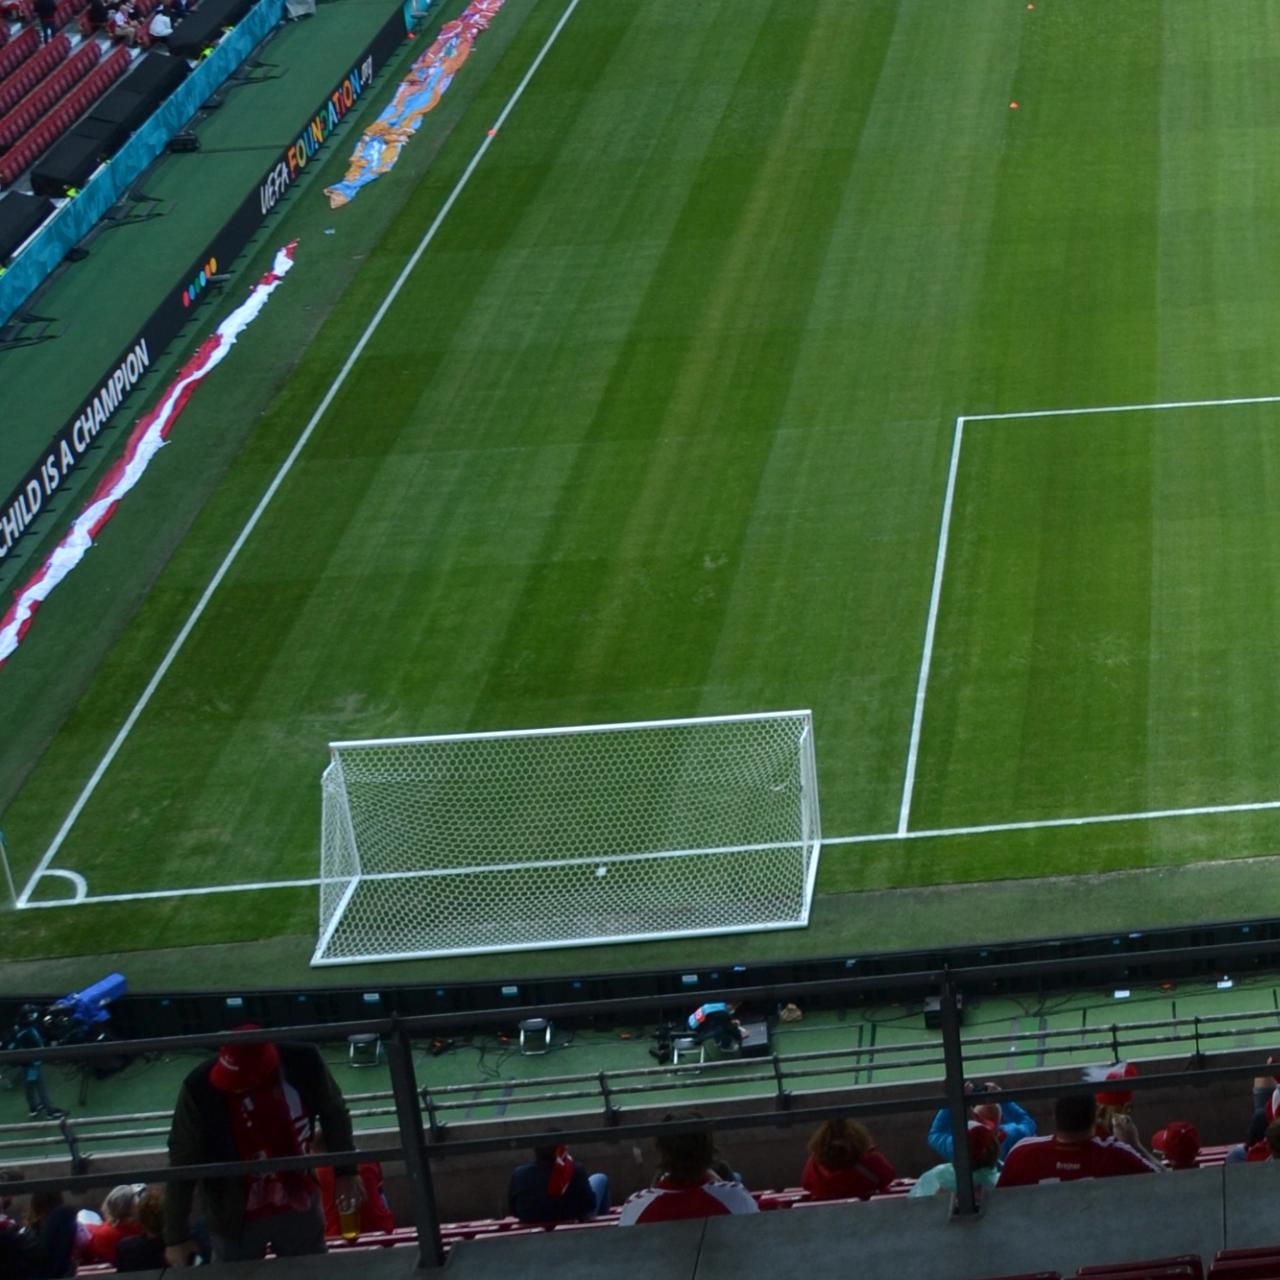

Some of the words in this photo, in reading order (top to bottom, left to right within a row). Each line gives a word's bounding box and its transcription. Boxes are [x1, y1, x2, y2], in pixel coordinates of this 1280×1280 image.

[260, 161, 290, 215] UEFA
[41, 453, 60, 495] IS
[60, 438, 75, 475] A
[72, 338, 150, 454] CHAMPION
